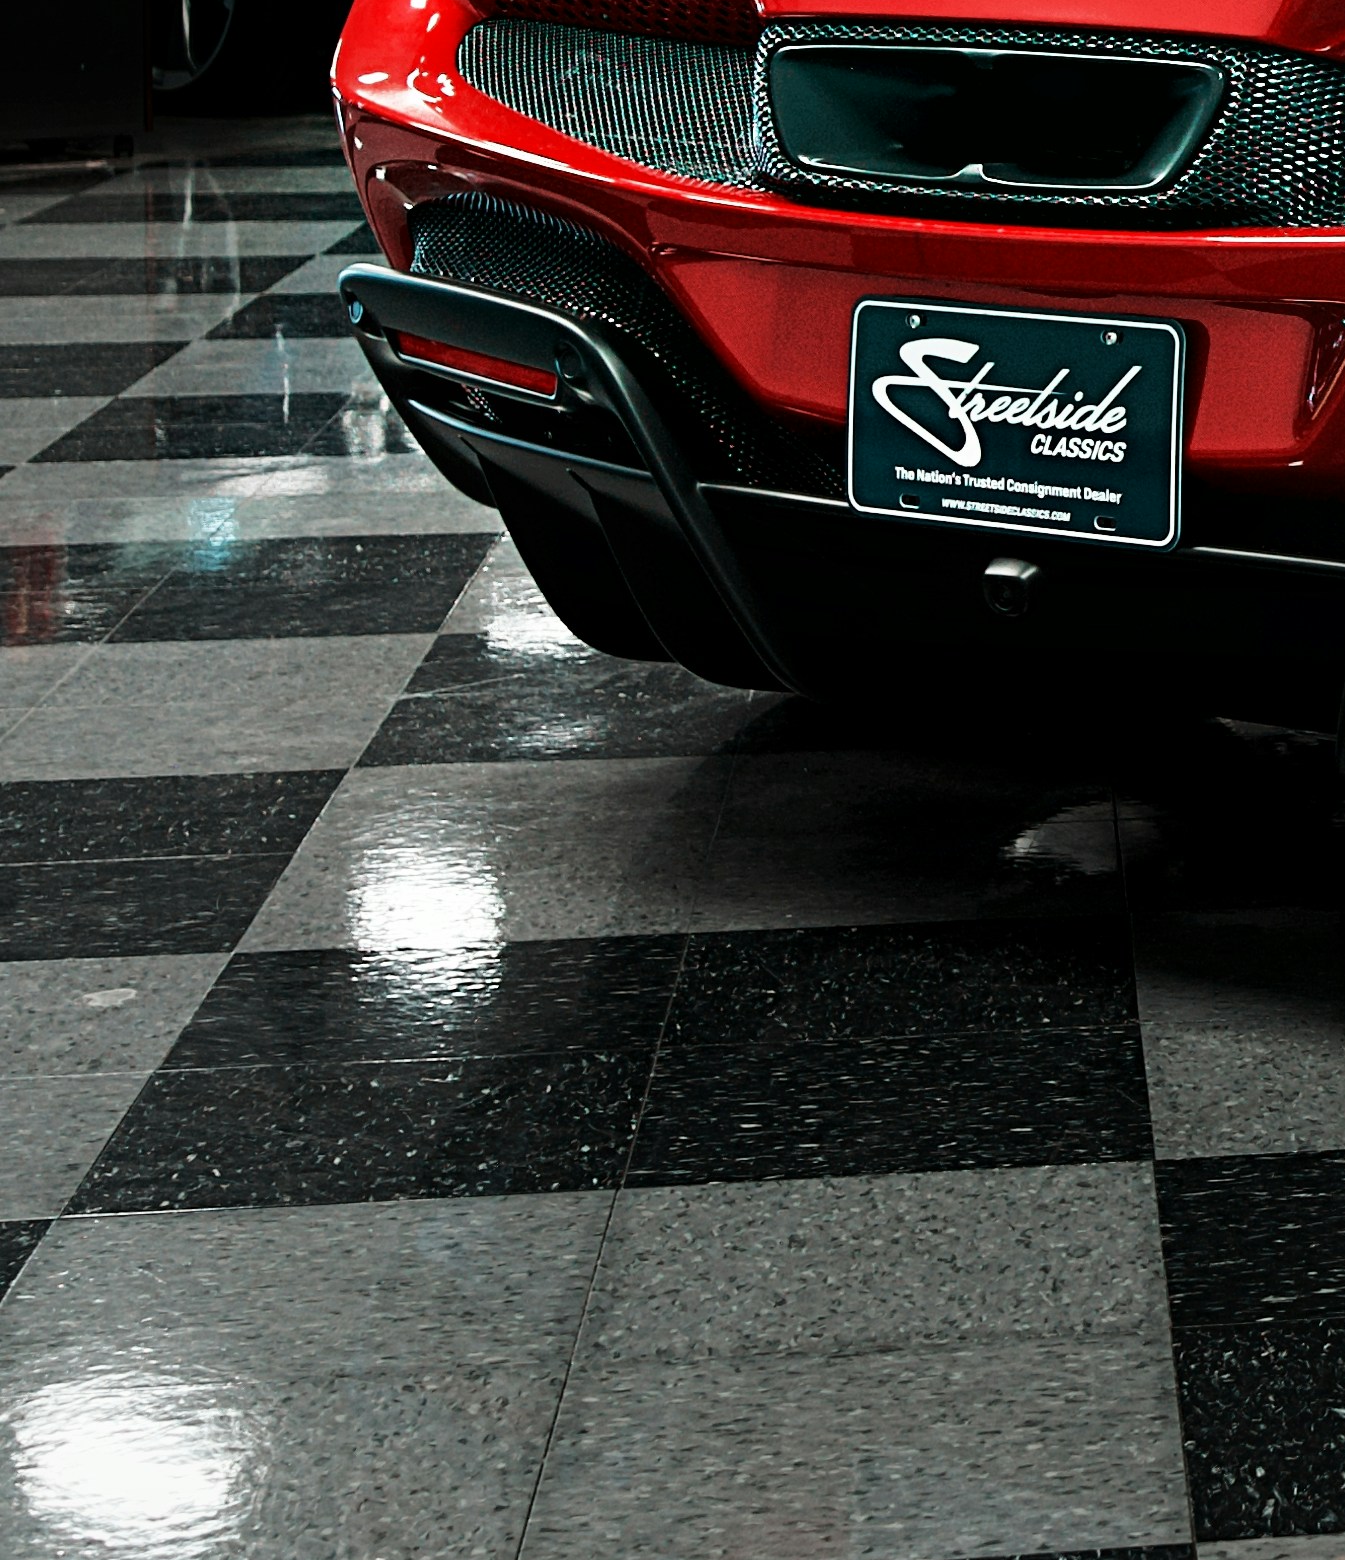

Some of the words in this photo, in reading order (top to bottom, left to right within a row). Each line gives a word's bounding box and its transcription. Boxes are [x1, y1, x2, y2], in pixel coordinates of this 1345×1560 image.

[872, 338, 1142, 467] Streetside
[1030, 433, 1127, 463] CLASSICS
[895, 466, 915, 481] The
[916, 468, 962, 486] Nation's
[962, 474, 1005, 492] Trusted
[1006, 478, 1082, 501] Consignment
[1083, 487, 1123, 506] Dealer
